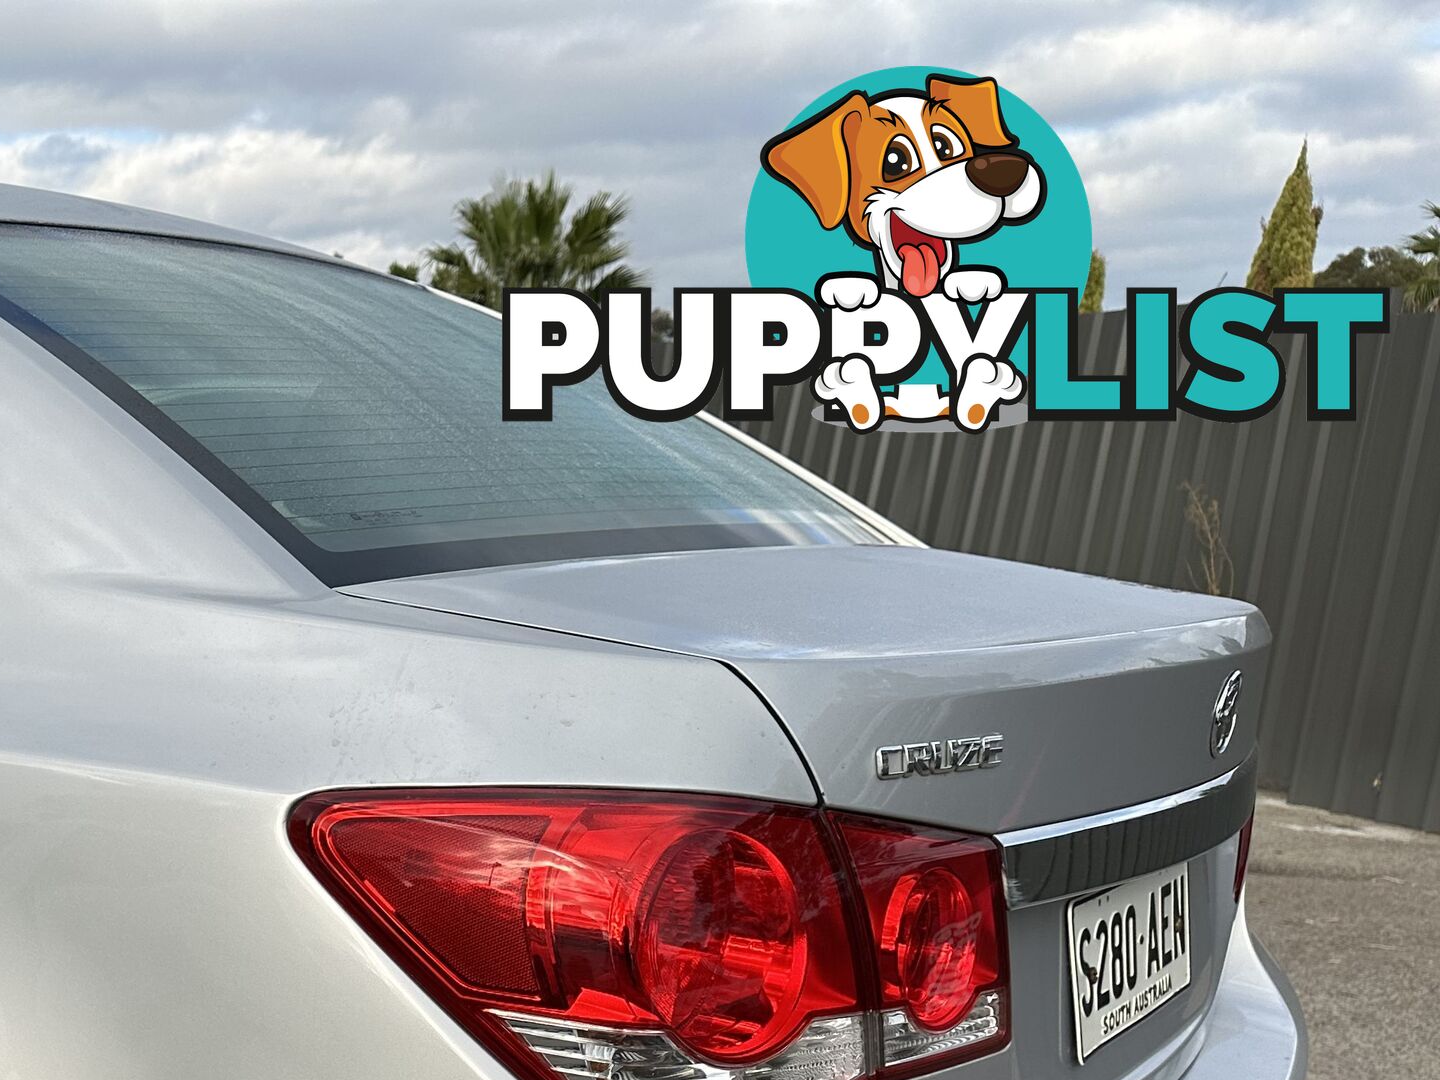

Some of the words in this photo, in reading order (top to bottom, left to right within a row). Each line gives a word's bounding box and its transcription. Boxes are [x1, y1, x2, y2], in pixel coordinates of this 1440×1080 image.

[875, 732, 1004, 780] CRUZE
[1102, 1001, 1132, 1035] SOUTH
[1133, 973, 1173, 1018] AUSTRALIA
